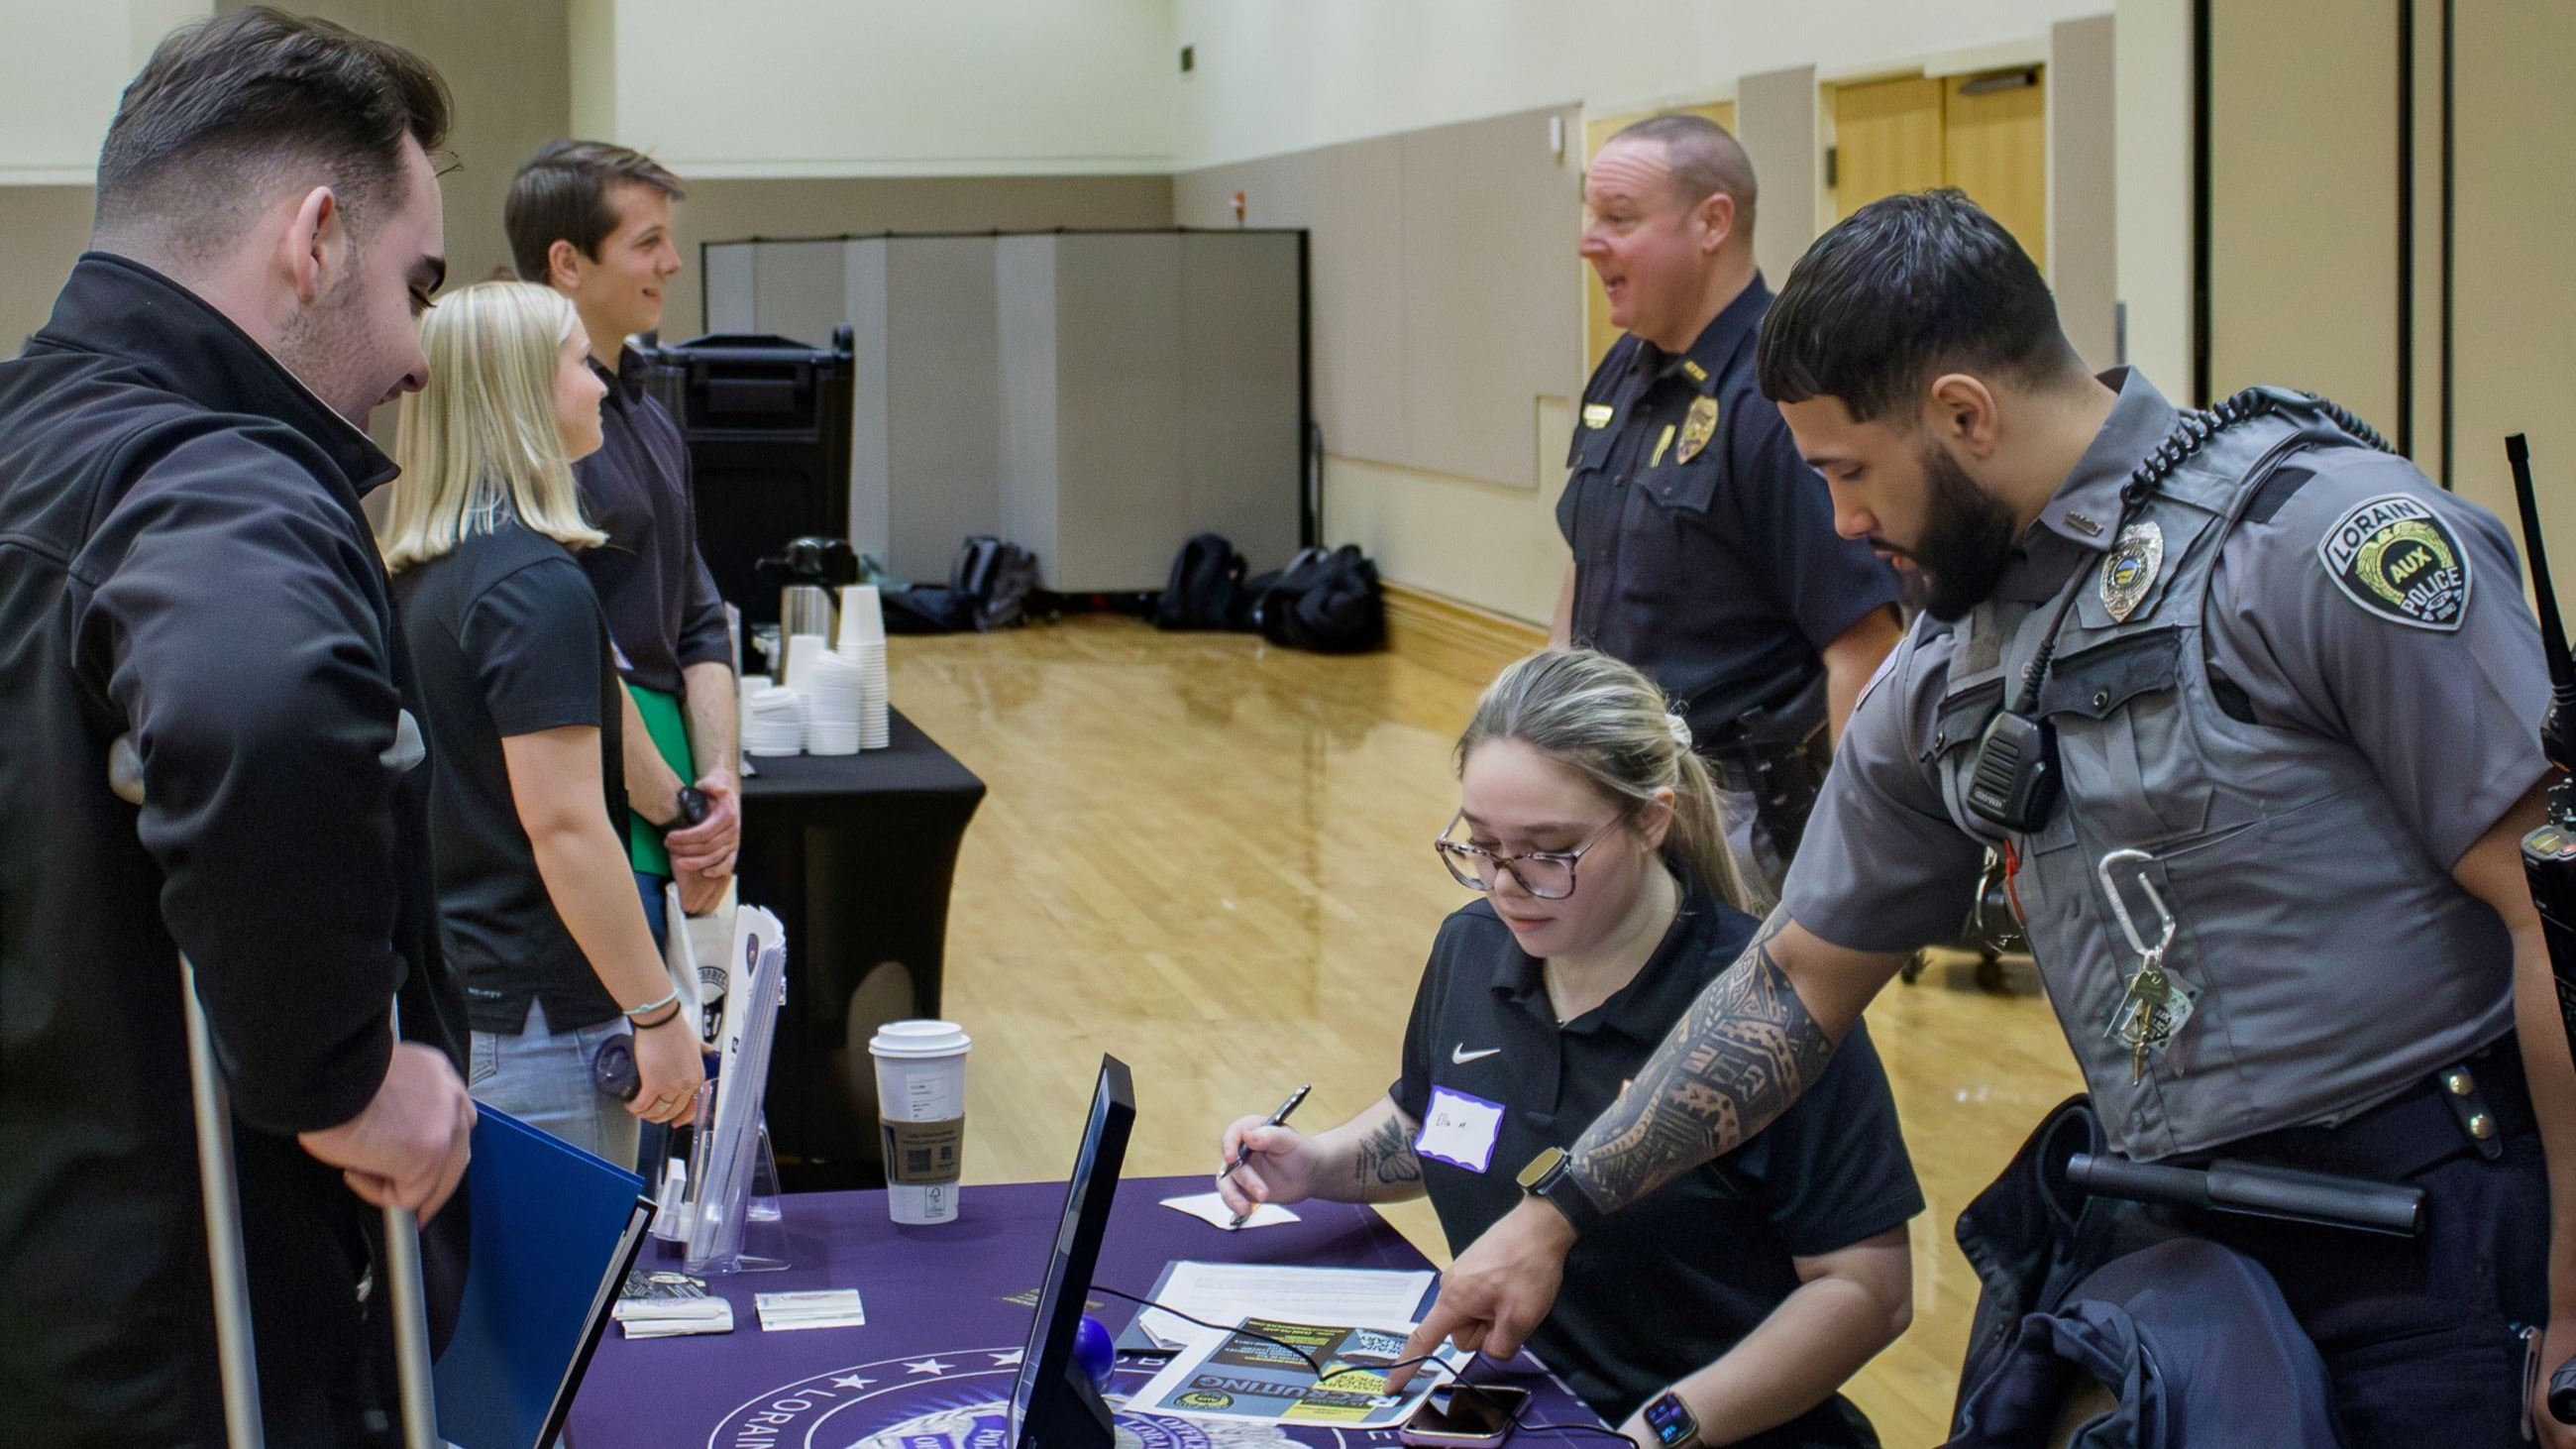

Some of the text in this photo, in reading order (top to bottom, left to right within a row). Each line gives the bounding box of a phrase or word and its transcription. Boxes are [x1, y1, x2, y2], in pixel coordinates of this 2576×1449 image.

[2334, 502, 2417, 563] LORAIN
[2389, 546, 2432, 584] AUX
[2400, 566, 2463, 617] POLICE
[1200, 1376, 1402, 1407] RECRUITING
